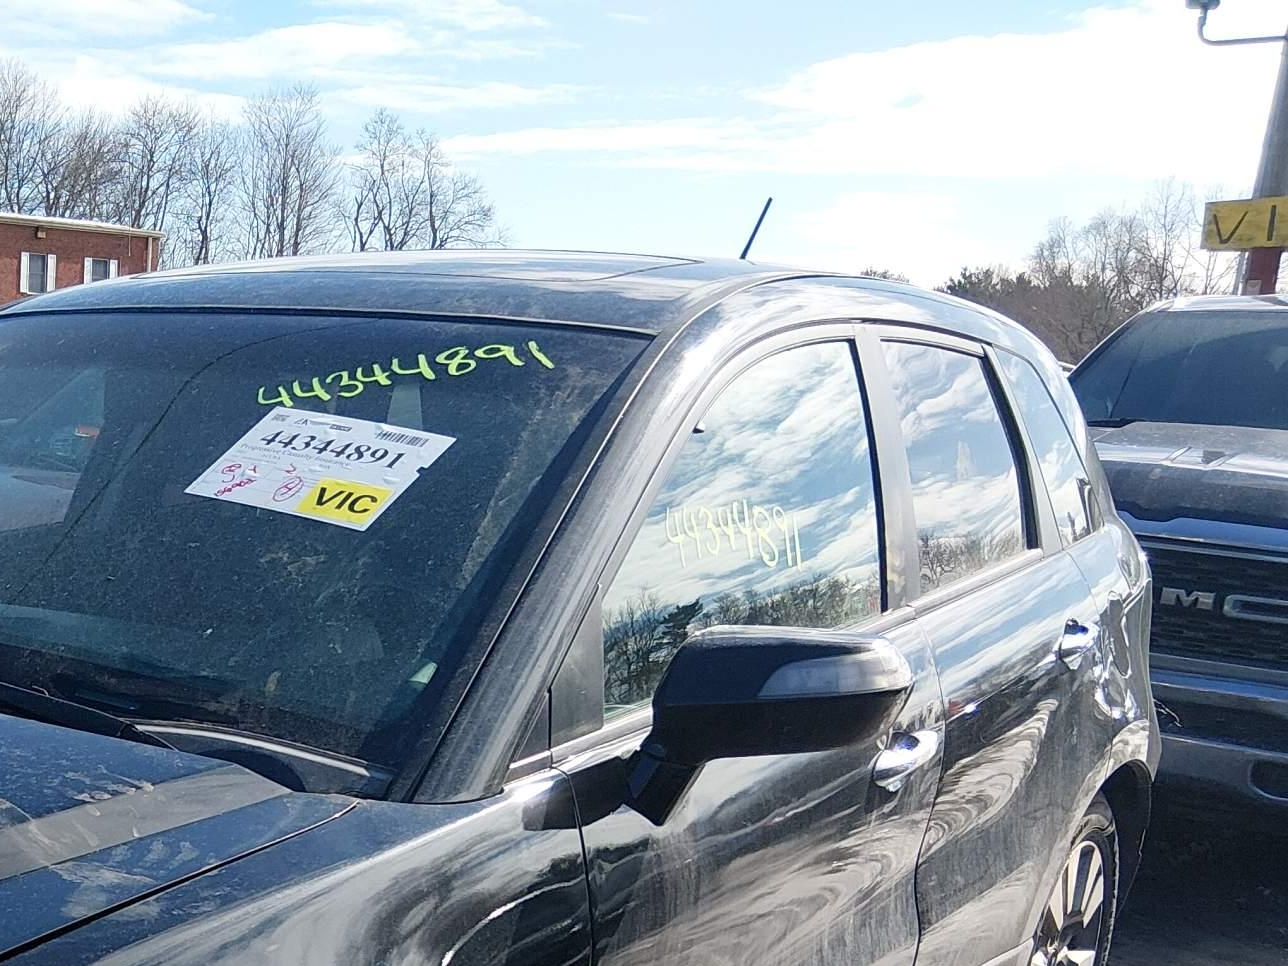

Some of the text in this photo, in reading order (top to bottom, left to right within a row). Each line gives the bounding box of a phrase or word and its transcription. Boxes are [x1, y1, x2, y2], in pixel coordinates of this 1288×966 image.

[257, 341, 555, 407] 44344891
[260, 429, 407, 469] 44344891
[316, 486, 378, 514] VIC
[665, 498, 803, 572] 44344891
[1161, 587, 1288, 625] MC
